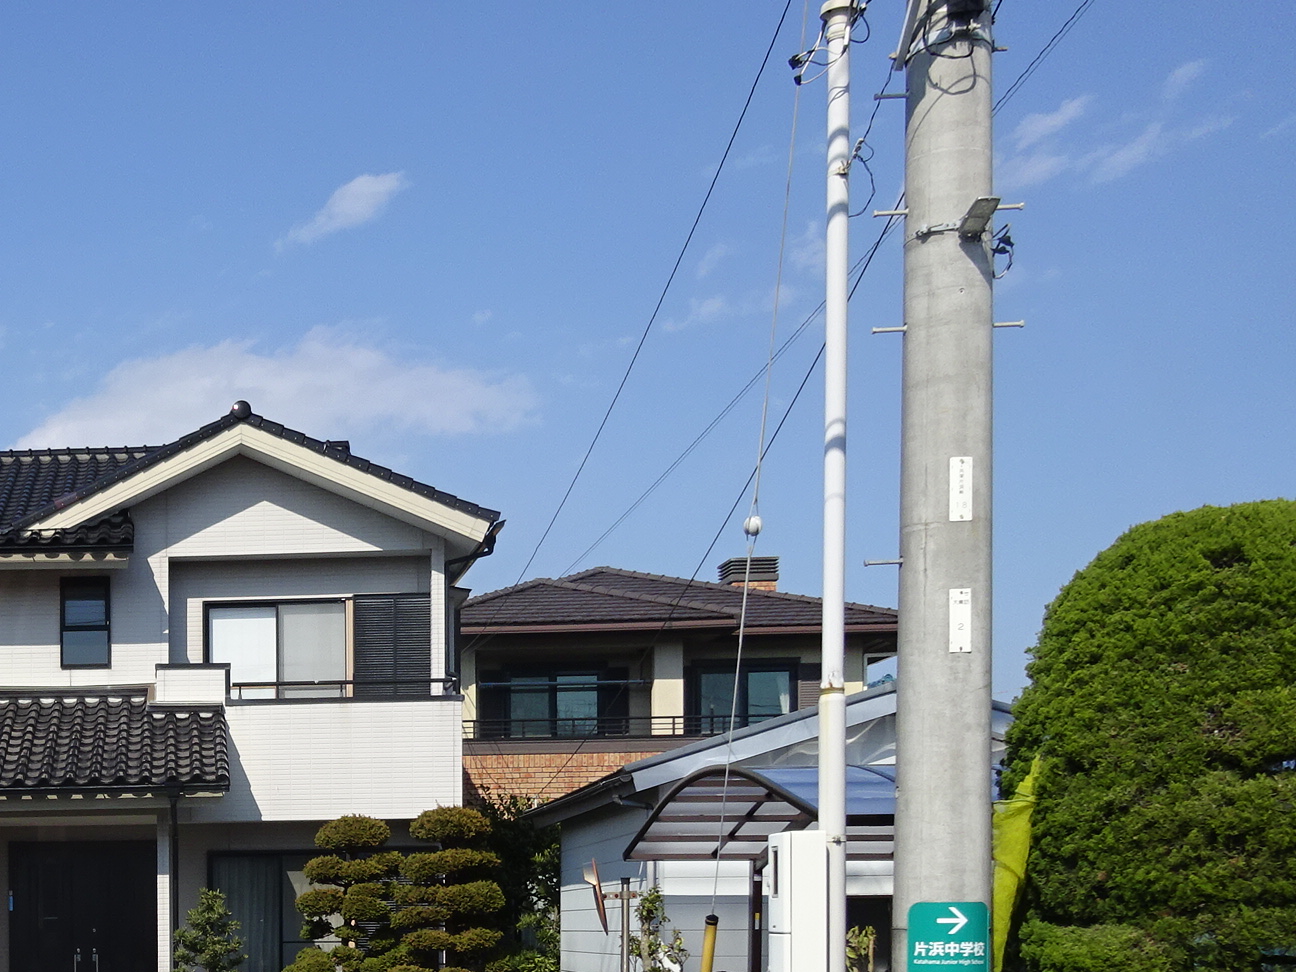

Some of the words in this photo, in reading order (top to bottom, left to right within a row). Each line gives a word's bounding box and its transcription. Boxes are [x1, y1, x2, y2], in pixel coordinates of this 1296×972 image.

[958, 622, 964, 631] 2
[913, 941, 985, 957] 片浜中学校
